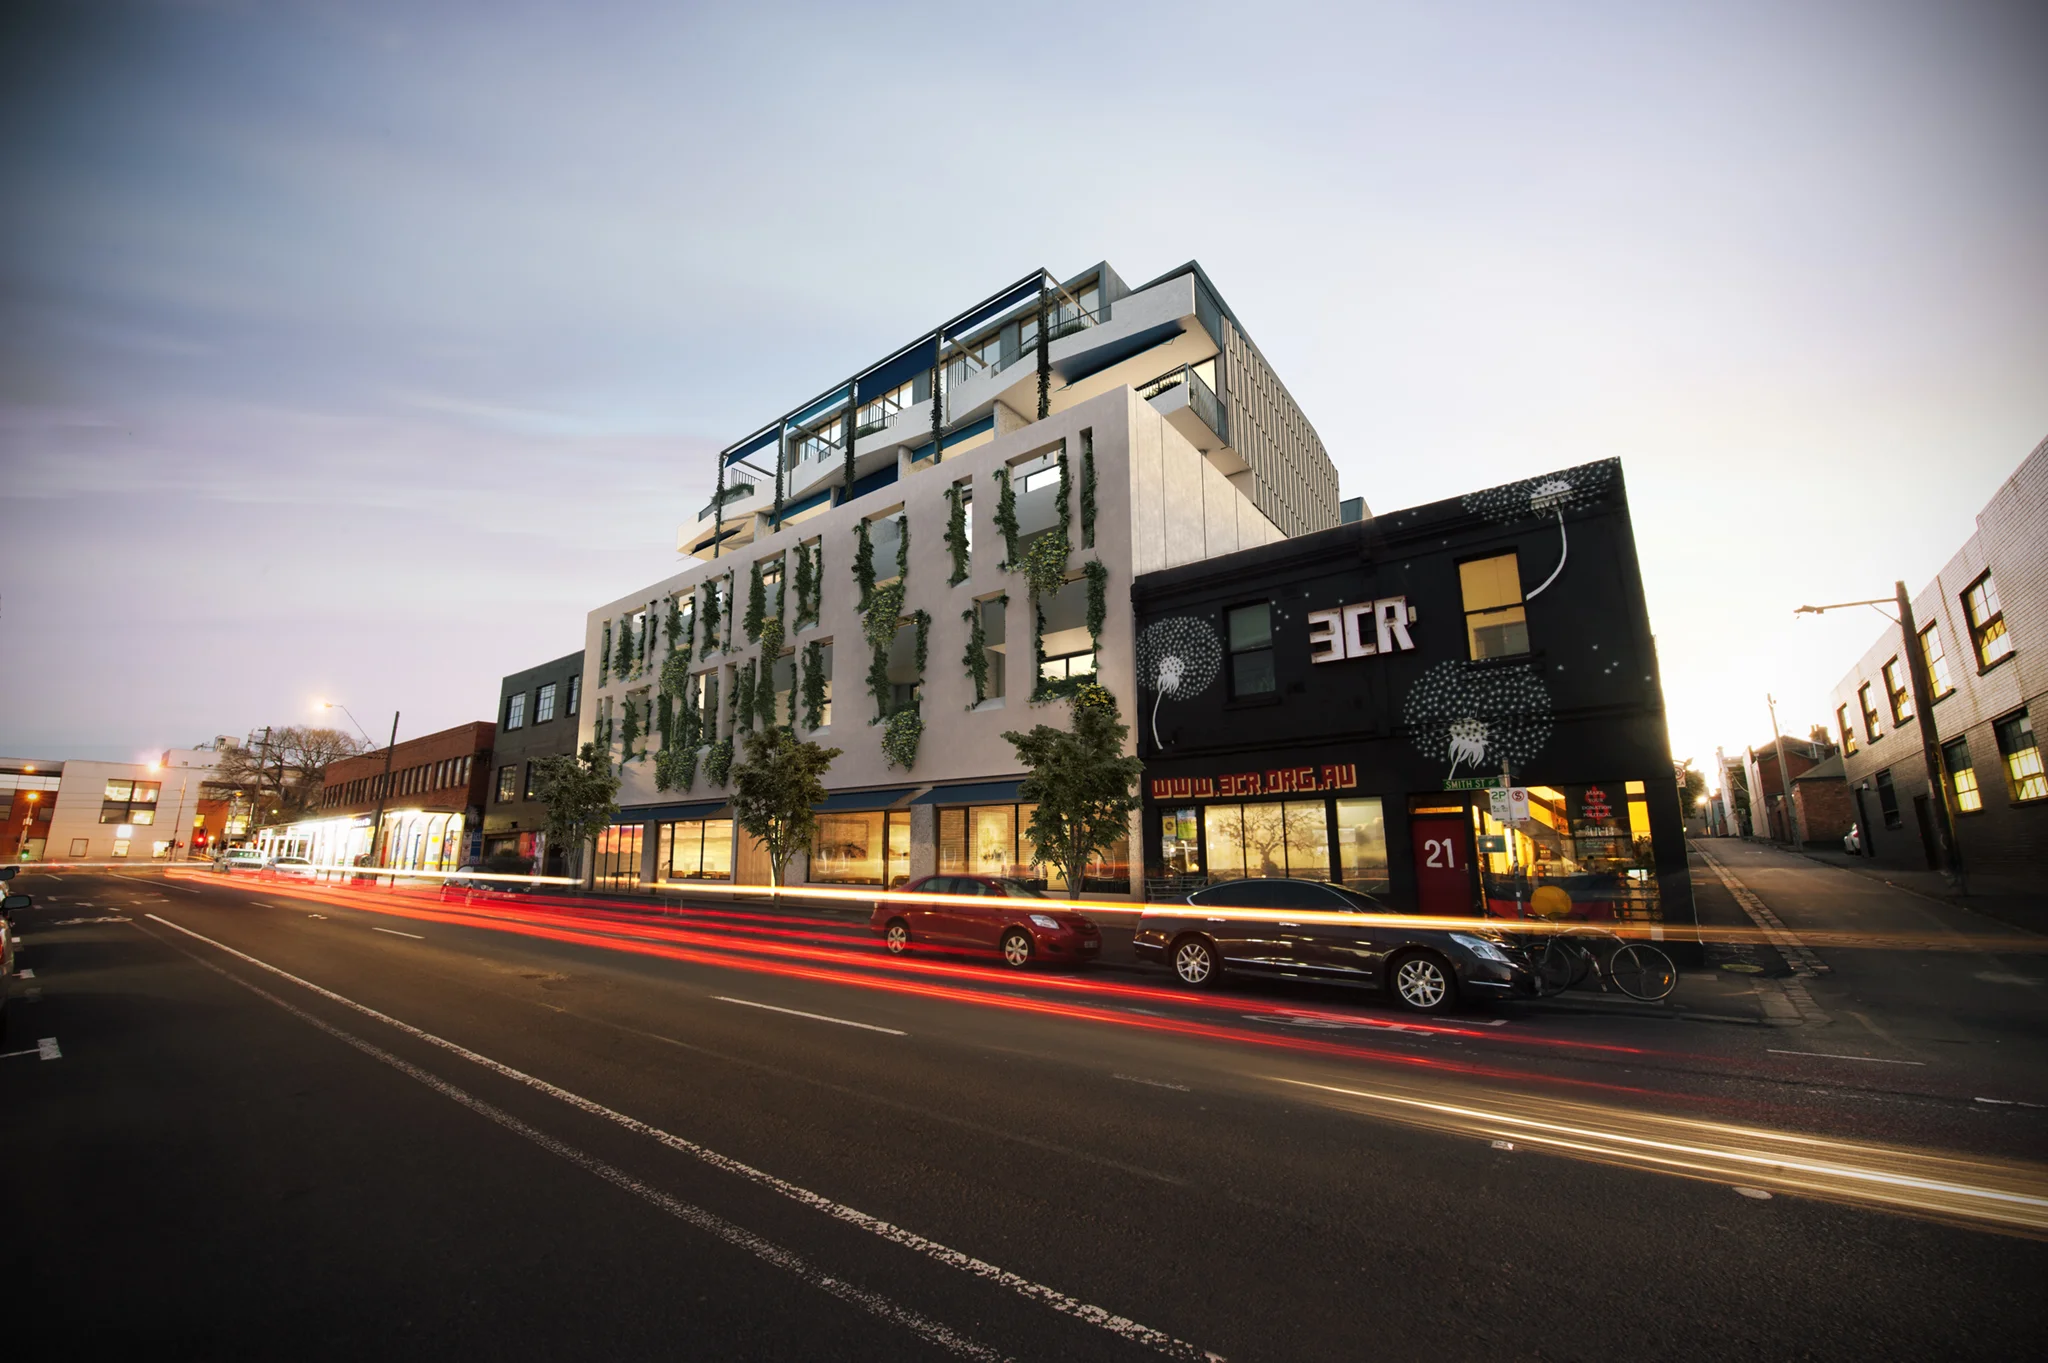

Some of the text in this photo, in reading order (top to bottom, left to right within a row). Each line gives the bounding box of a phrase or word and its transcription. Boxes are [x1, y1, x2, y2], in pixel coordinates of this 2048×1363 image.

[1308, 595, 1415, 664] 3CR
[1446, 780, 1472, 790] SMITH
[1475, 779, 1485, 788] ST
[1491, 791, 1506, 800] 2P
[1424, 838, 1454, 868] 21
